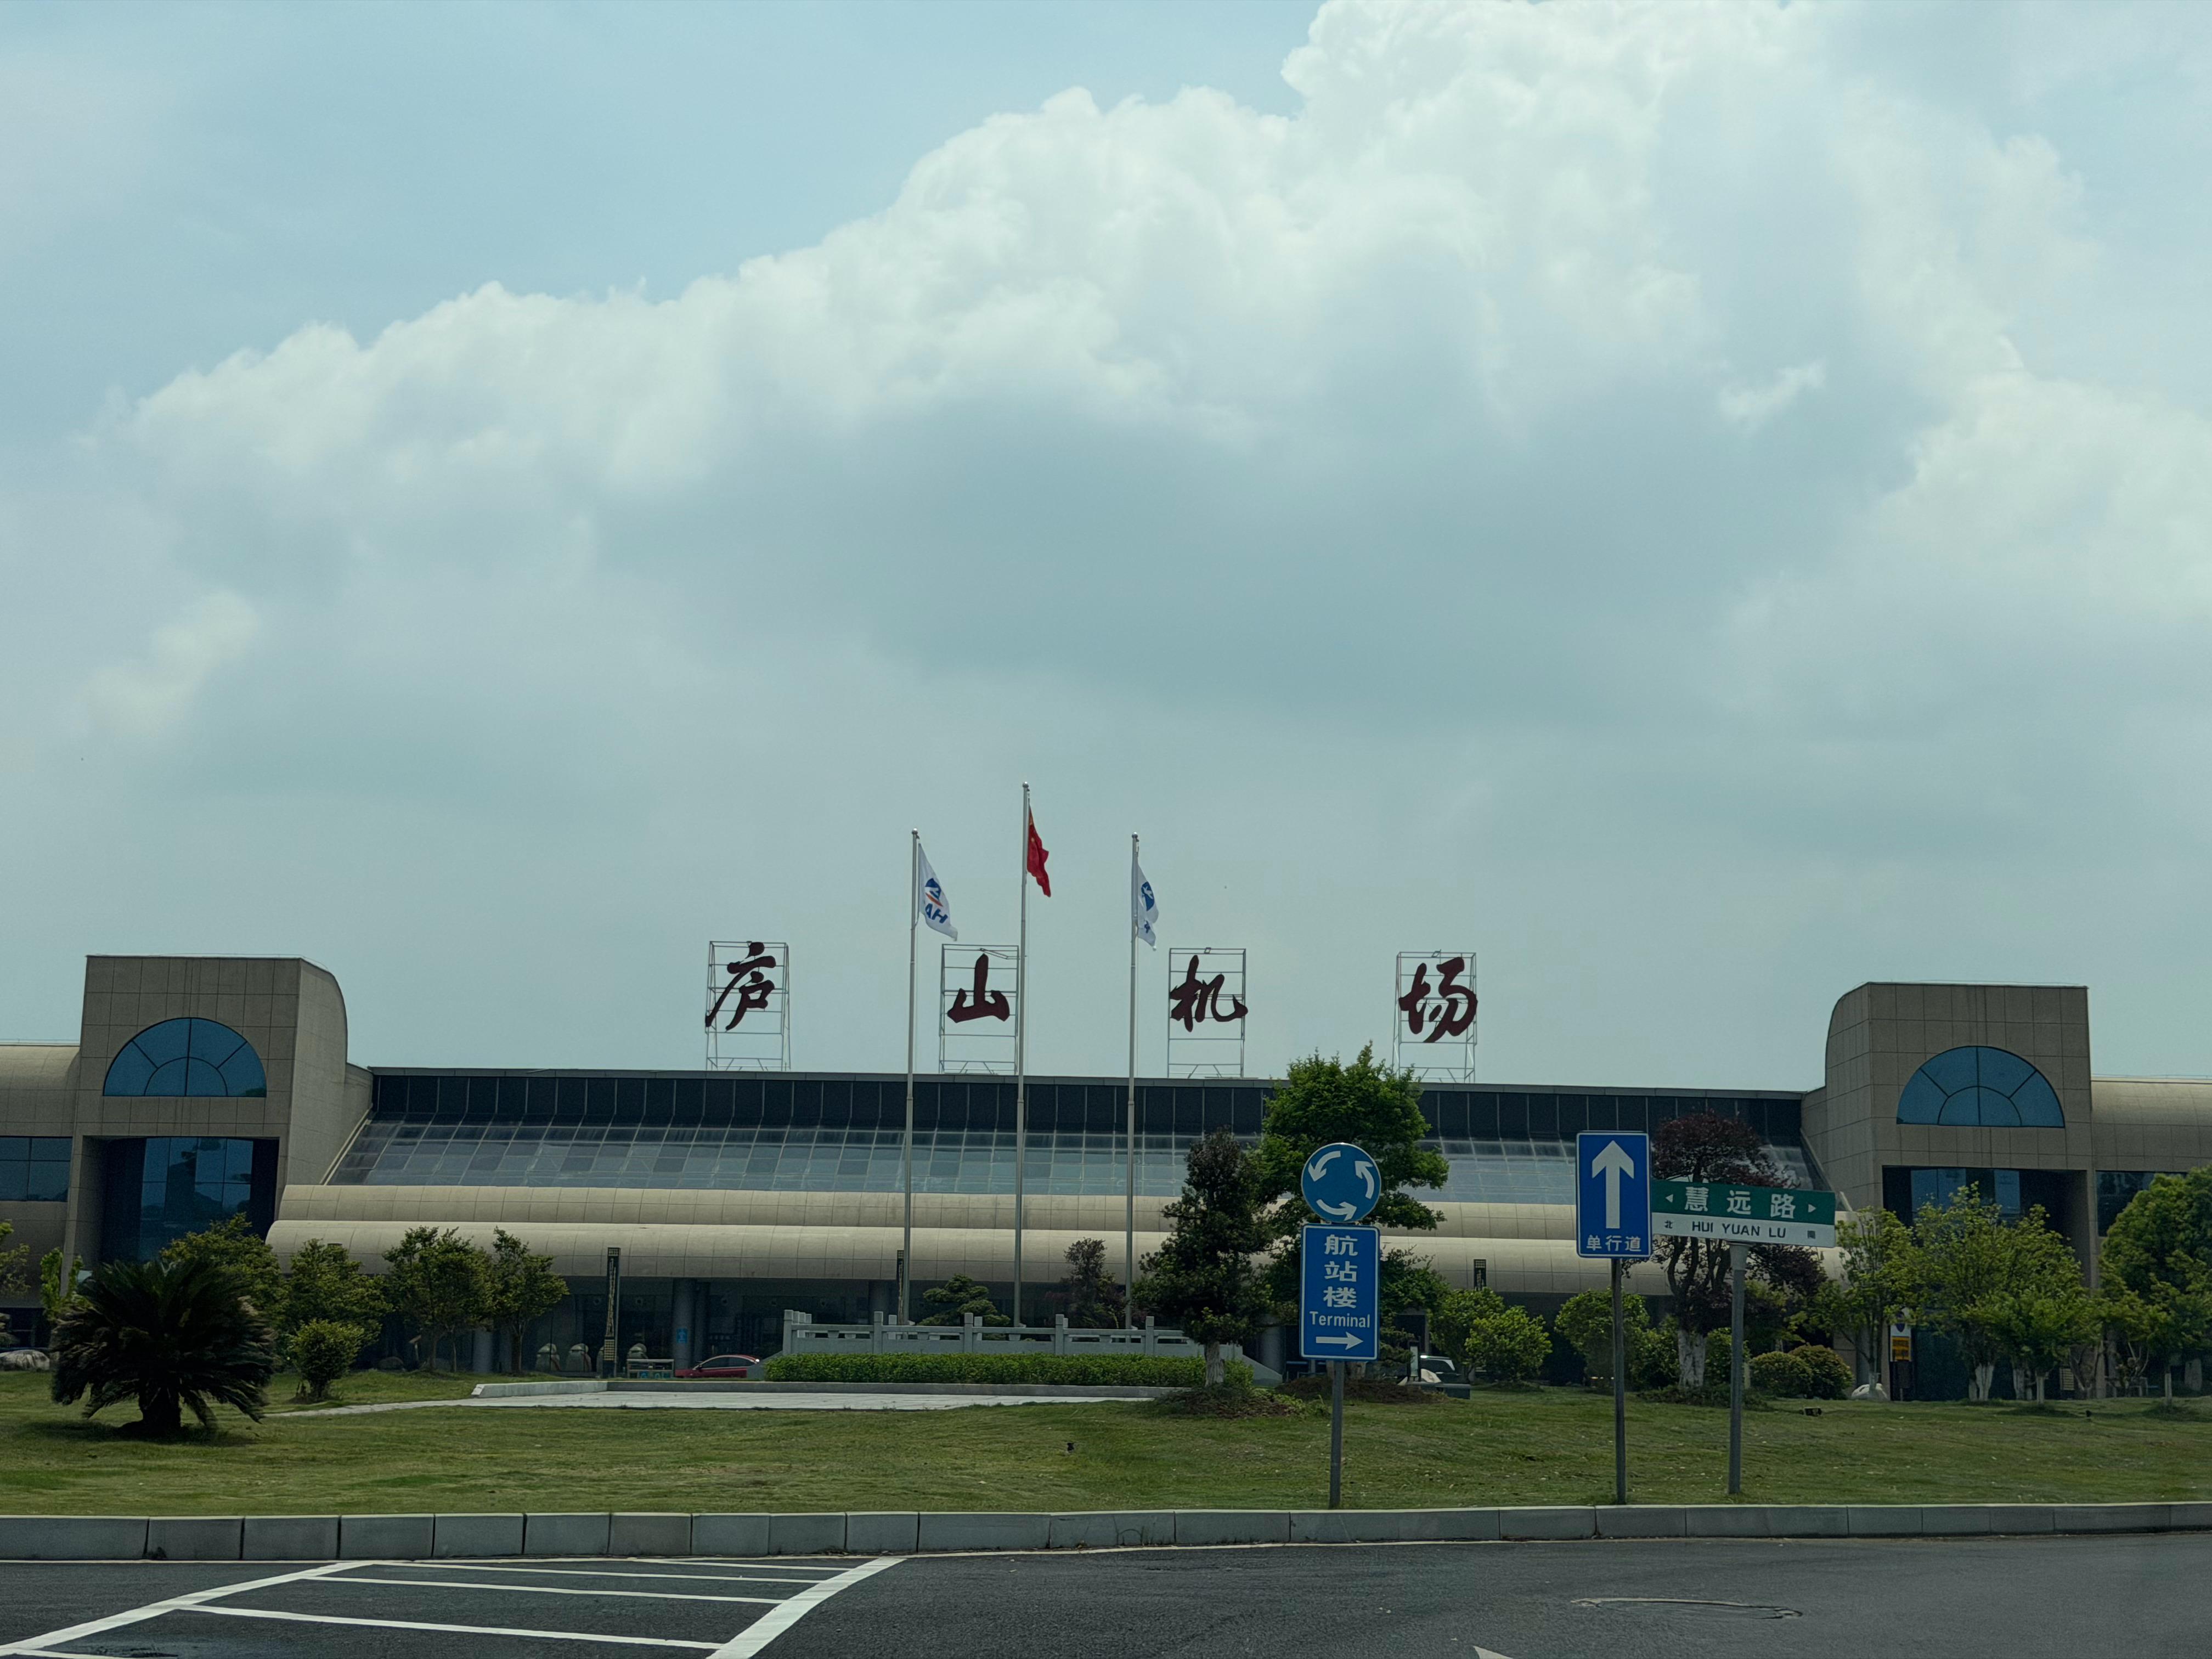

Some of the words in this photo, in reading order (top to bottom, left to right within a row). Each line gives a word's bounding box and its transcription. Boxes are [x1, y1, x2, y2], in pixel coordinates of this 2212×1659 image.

[705, 942, 1478, 1043] 庐山机场
[1685, 1187, 1796, 1219] 慧远路
[1692, 1221, 1713, 1233] HUI
[1722, 1223, 1760, 1238] YUAN
[1769, 1228, 1786, 1238] LU
[1586, 1234, 1641, 1251] 单行道
[1323, 1234, 1358, 1308] 航站楼
[1310, 1311, 1370, 1328] Terminal
